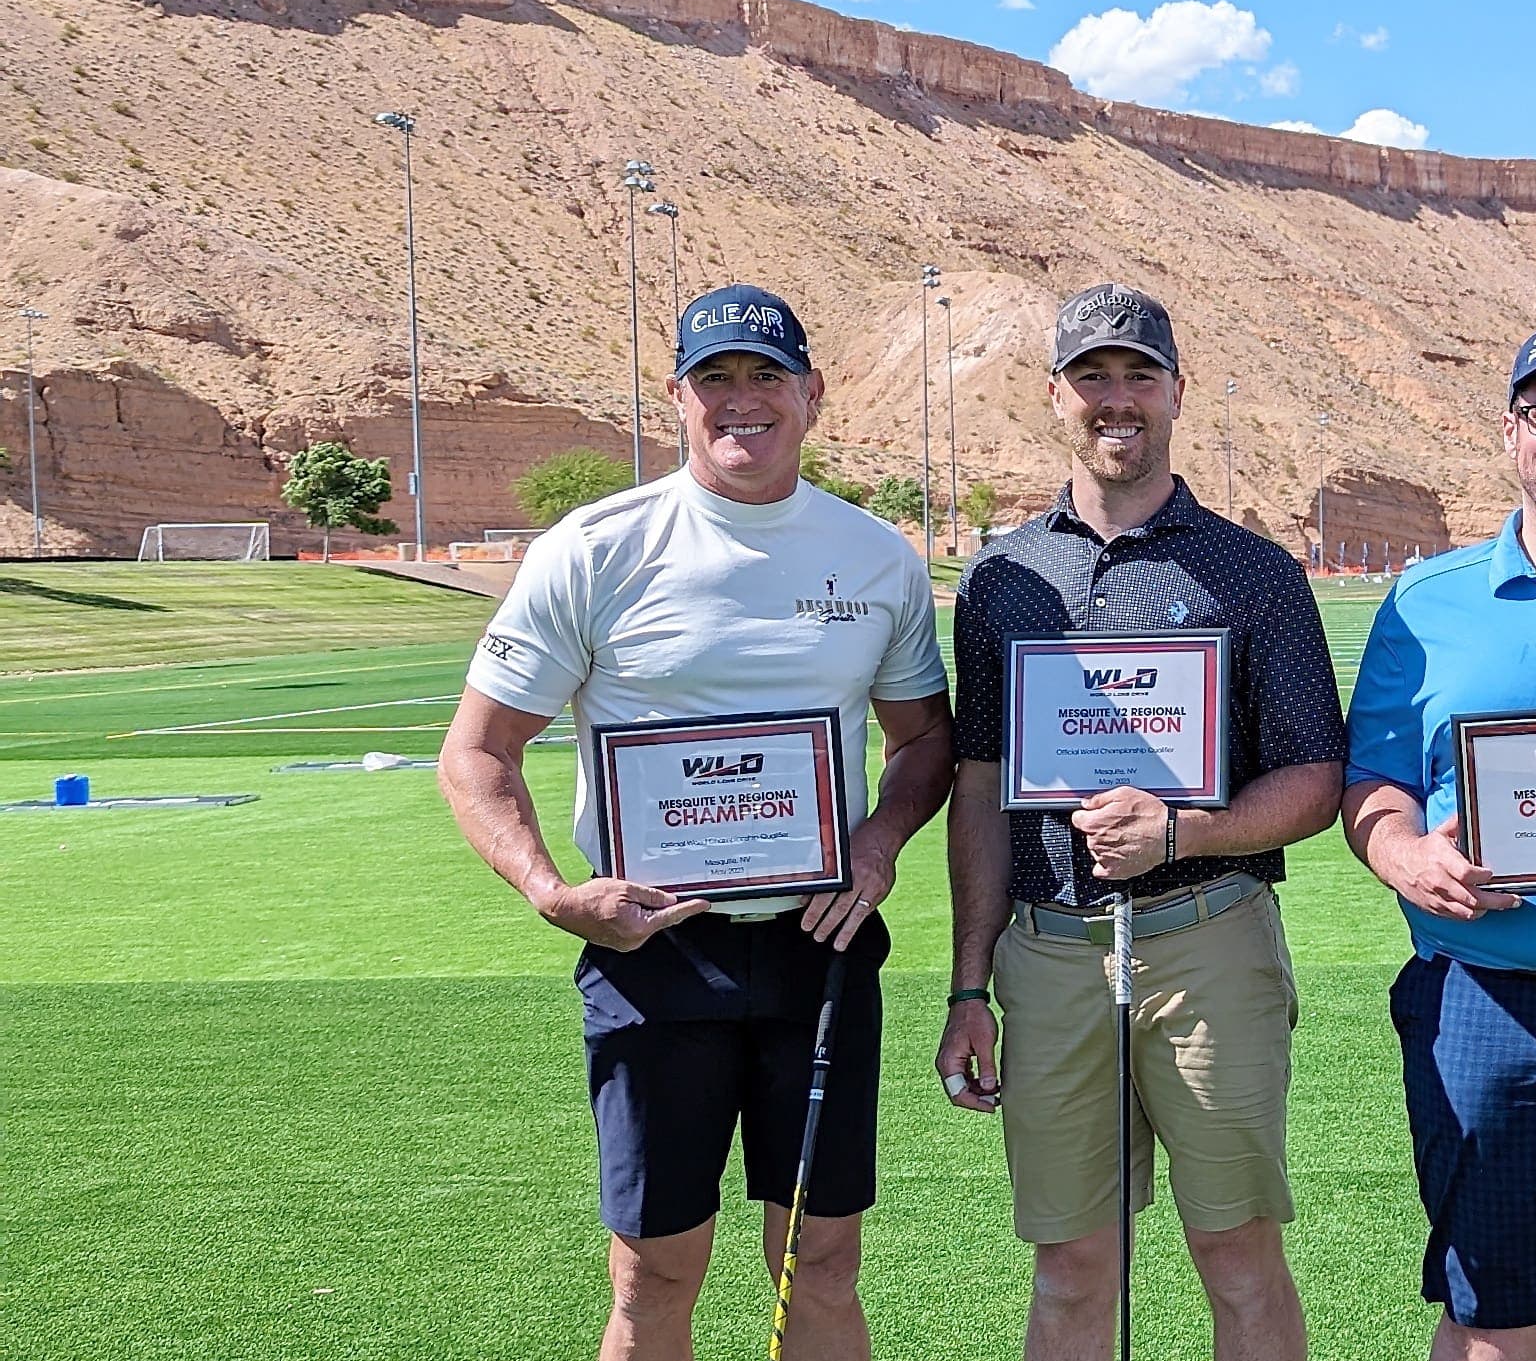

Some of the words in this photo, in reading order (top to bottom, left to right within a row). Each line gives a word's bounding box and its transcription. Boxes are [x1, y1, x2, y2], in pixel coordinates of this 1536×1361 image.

[691, 303, 784, 332] CLEAR
[1076, 291, 1150, 321] Callaway
[1083, 668, 1158, 690] WLD
[1058, 708, 1110, 718] MESQUITE
[1113, 707, 1128, 717] V2
[1131, 706, 1186, 716] REGIONAL
[1062, 716, 1181, 735] CHAMPION
[682, 753, 764, 778] WLD
[658, 796, 716, 810] MESQUITE
[719, 794, 735, 805] V2
[738, 789, 798, 803] REGIONAL
[664, 800, 794, 827] CHAMPION
